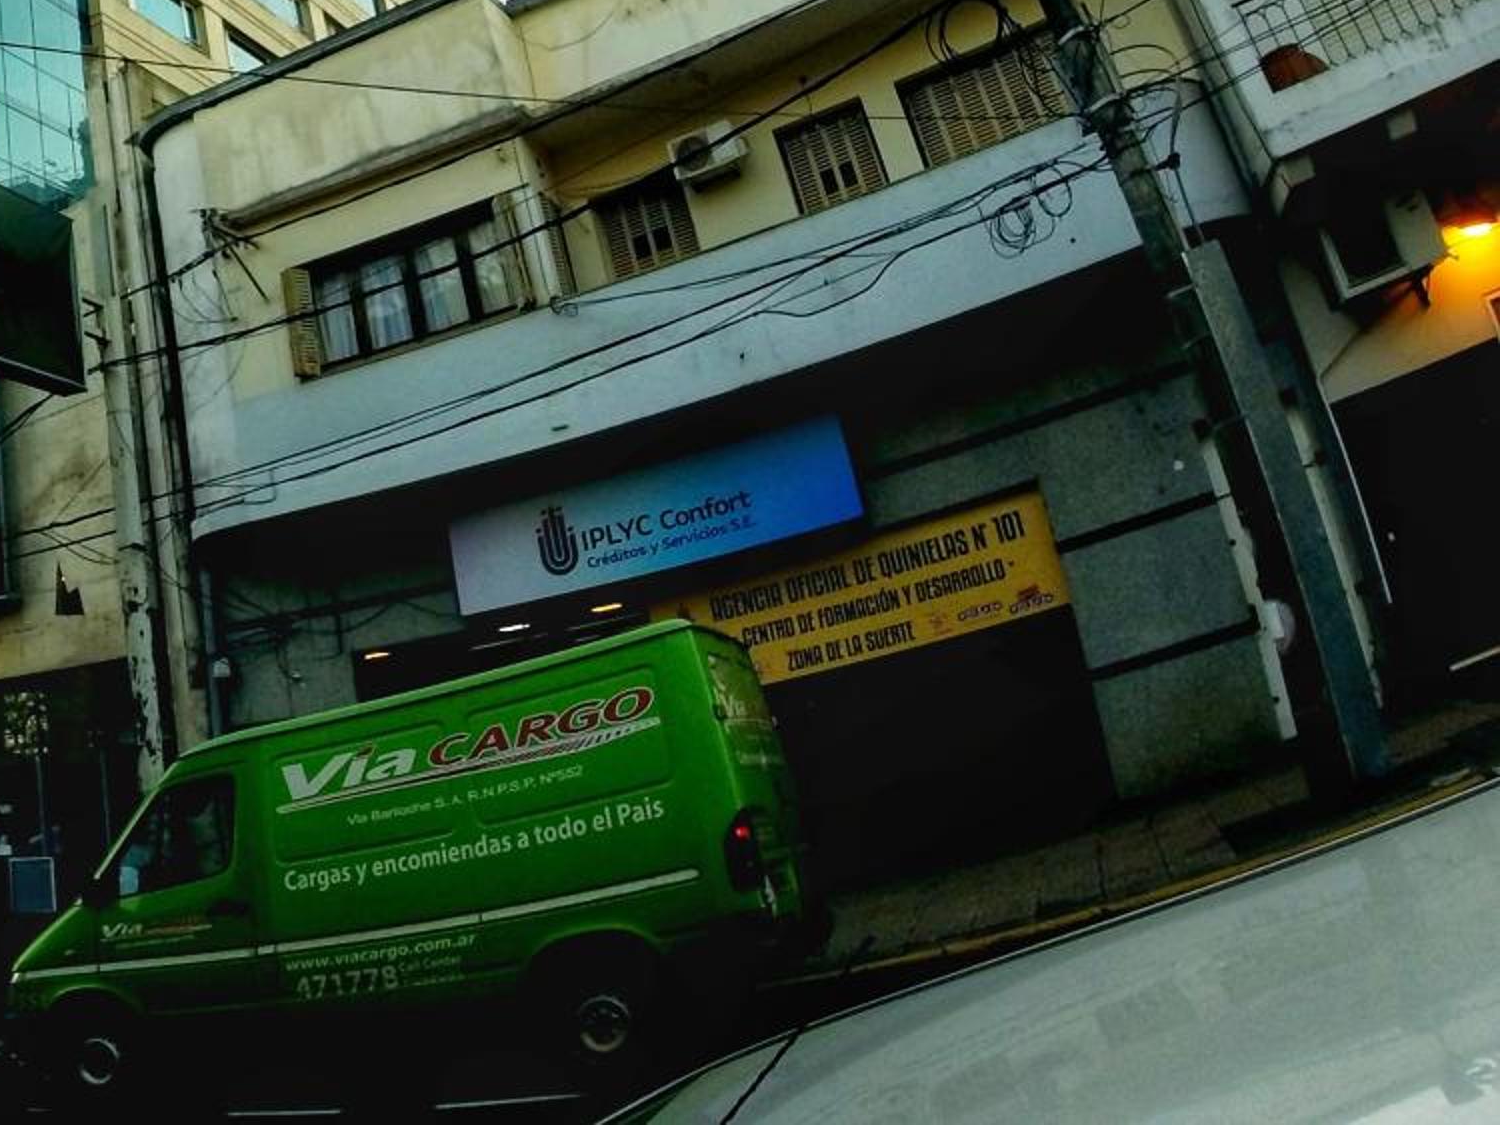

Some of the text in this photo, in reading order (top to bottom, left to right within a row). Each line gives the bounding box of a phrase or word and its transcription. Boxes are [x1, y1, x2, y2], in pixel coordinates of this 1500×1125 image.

[581, 490, 752, 551] IPLYC Confort
[587, 545, 647, 568] Créditos
[662, 525, 727, 551] Servicios
[708, 587, 783, 621] AGENCIA
[785, 571, 852, 604] OFICIAL
[852, 558, 876, 585] DE
[878, 529, 970, 578] QUINIELAS
[991, 510, 1026, 544] 101
[741, 616, 795, 649] CENTRO
[797, 611, 817, 633] DE
[818, 589, 902, 629] FORMACIÓN
[902, 584, 914, 605] Y
[915, 559, 1007, 603] DESARROLLO
[787, 621, 916, 672] ZONA DE LA SUERTE
[427, 686, 655, 768] CARGO
[283, 866, 352, 892] Cargas
[355, 864, 367, 885] y
[371, 835, 512, 877] encomiendas
[516, 832, 530, 849] a
[532, 815, 588, 847] todo
[592, 808, 613, 832] el
[285, 934, 477, 972] www.viacargo.com.ar
[295, 963, 399, 1001] 471778
